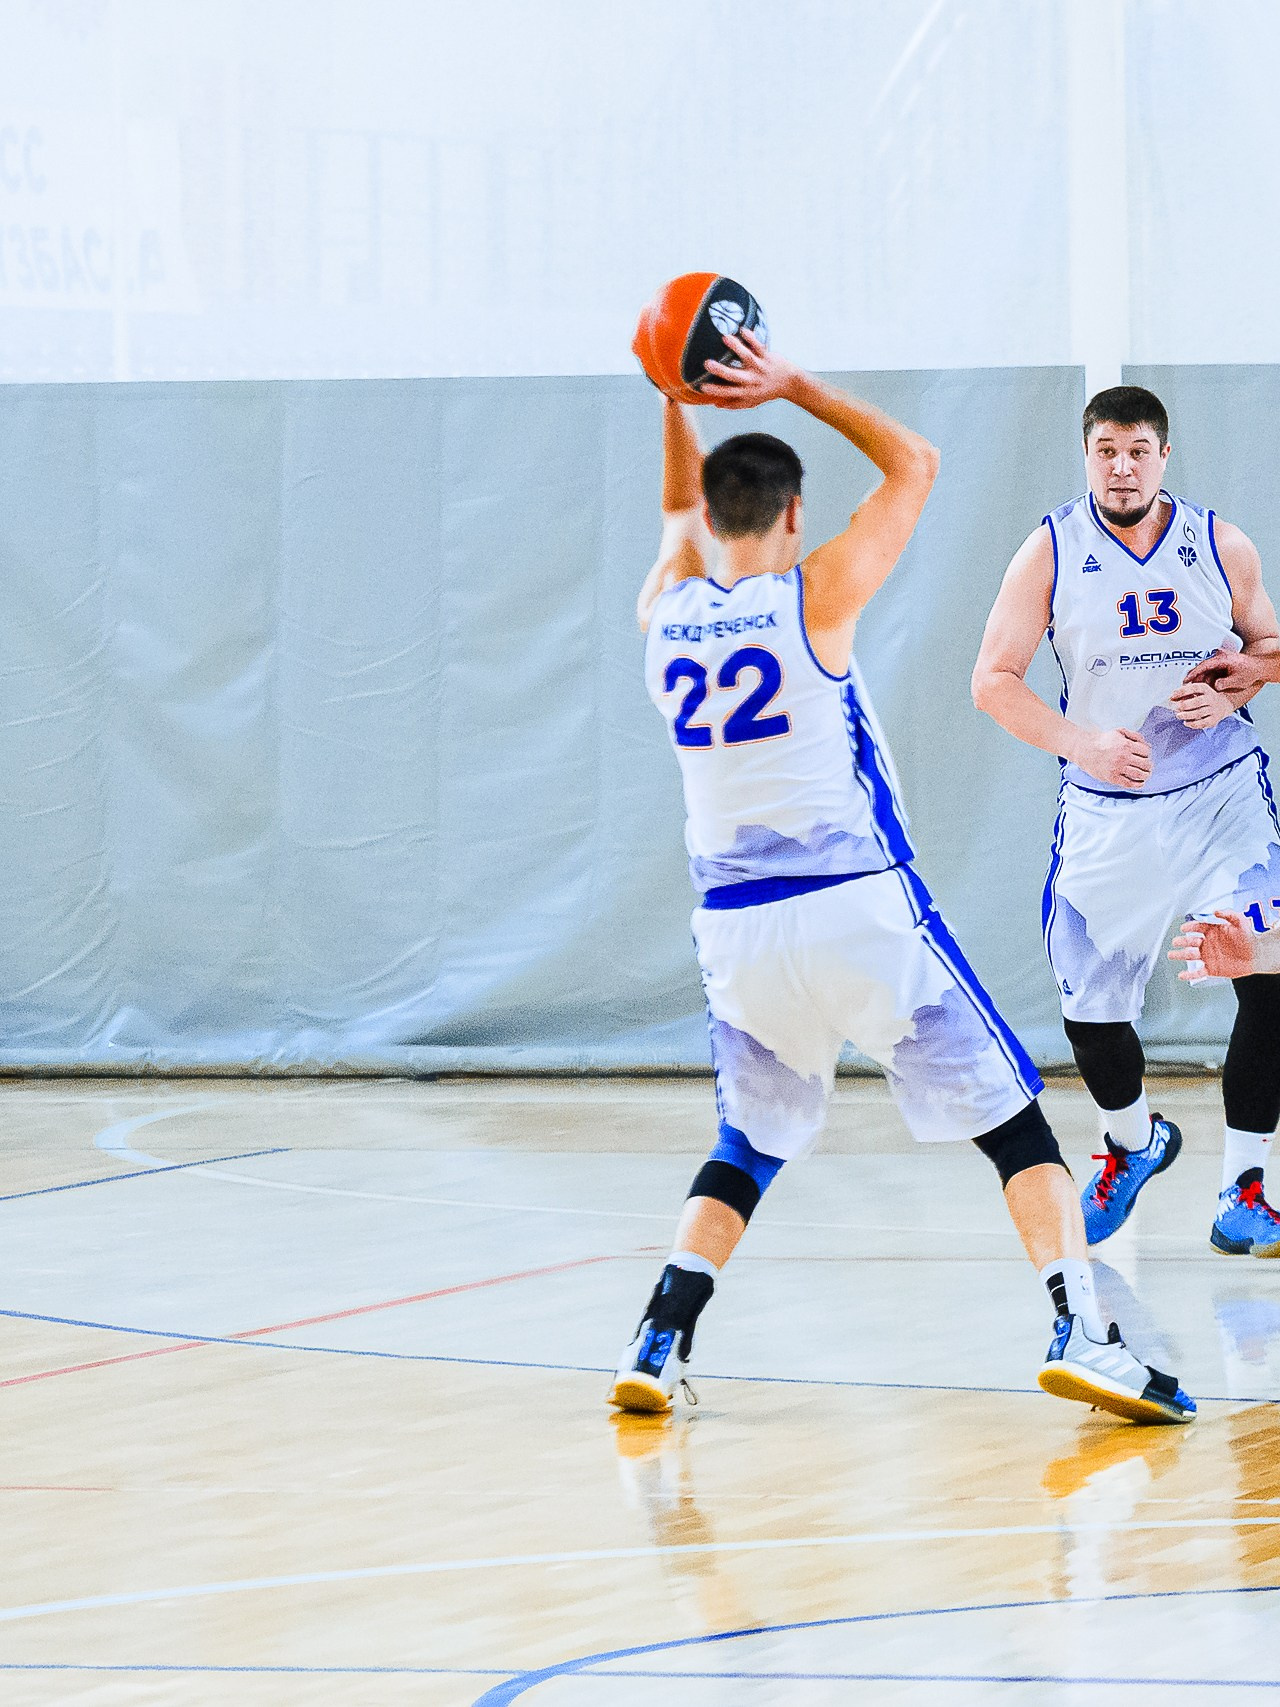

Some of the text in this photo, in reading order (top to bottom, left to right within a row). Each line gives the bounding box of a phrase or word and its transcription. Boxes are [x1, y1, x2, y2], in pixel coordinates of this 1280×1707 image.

[661, 611, 777, 643] МЕЖДРЕЧЕНСК
[1117, 588, 1181, 638] 13
[662, 644, 792, 750] 22
